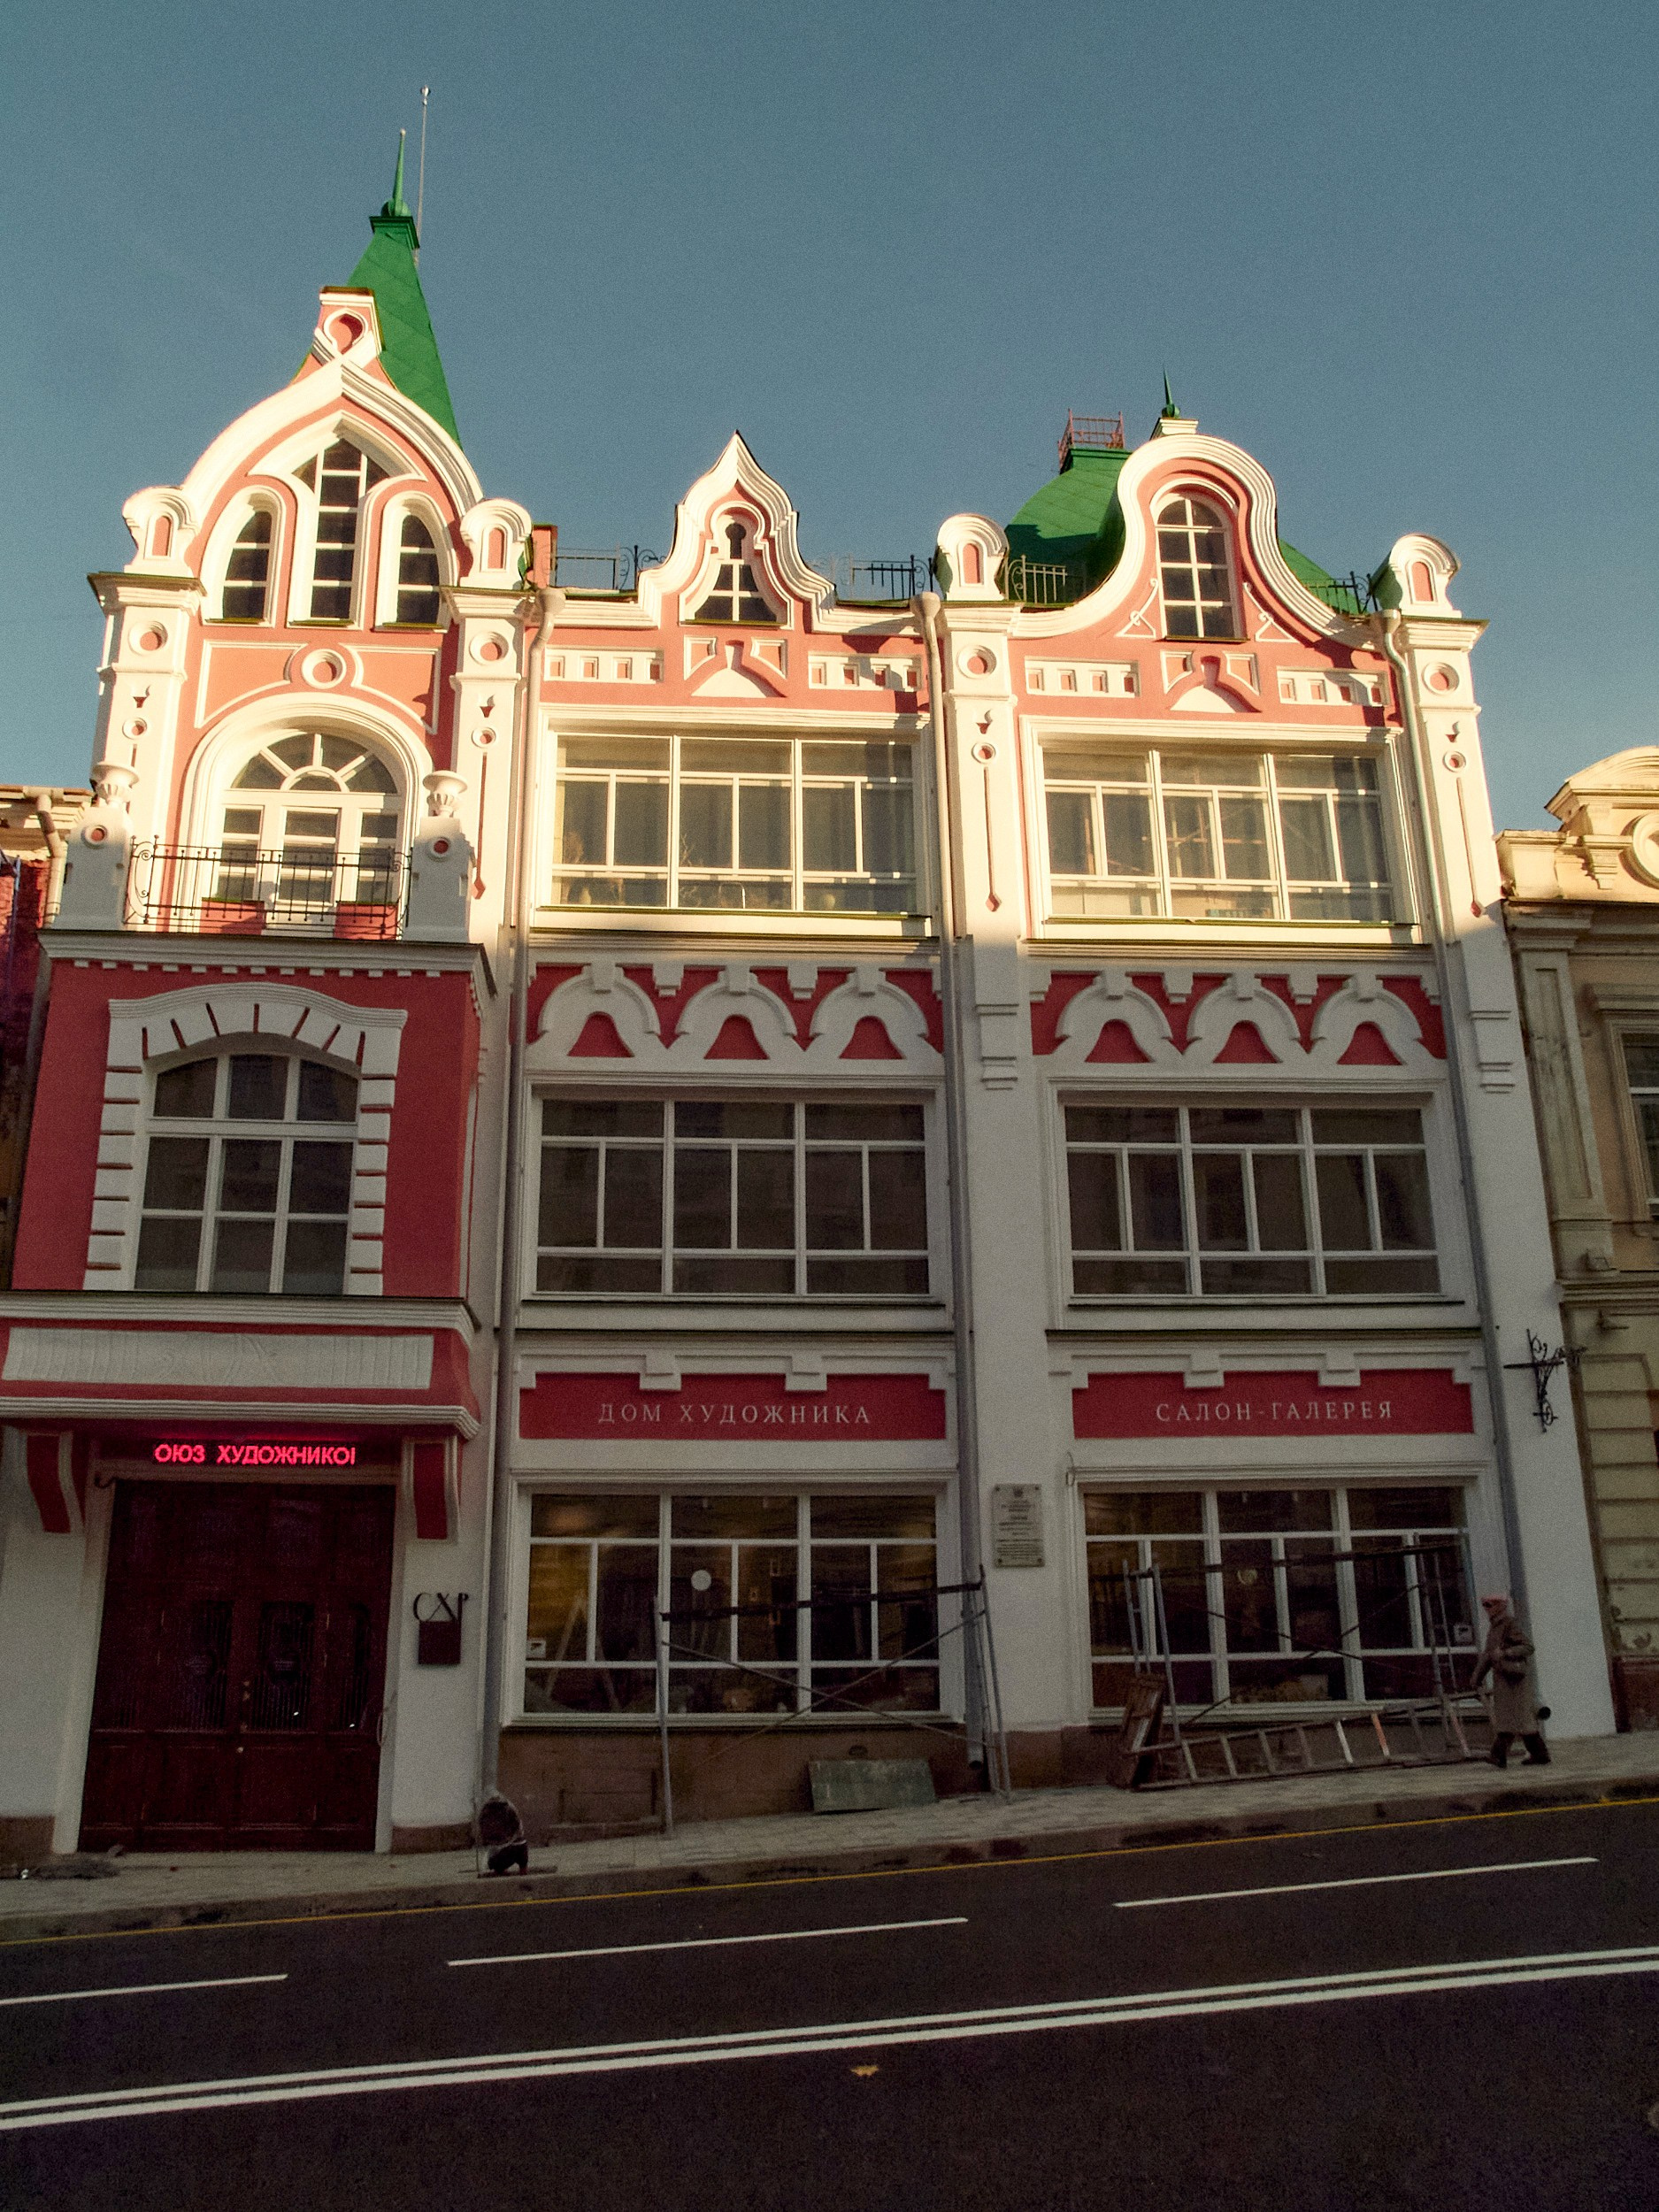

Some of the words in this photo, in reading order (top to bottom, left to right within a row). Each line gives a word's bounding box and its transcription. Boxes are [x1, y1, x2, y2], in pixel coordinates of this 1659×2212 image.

[597, 1403, 662, 1424] ДОМ
[680, 1403, 871, 1425] ХУДОЖНИКА
[1156, 1401, 1392, 1422] САЛОН-ГАЛЕРЕЯ
[217, 1445, 356, 1465] ХУДОЖНИКО
